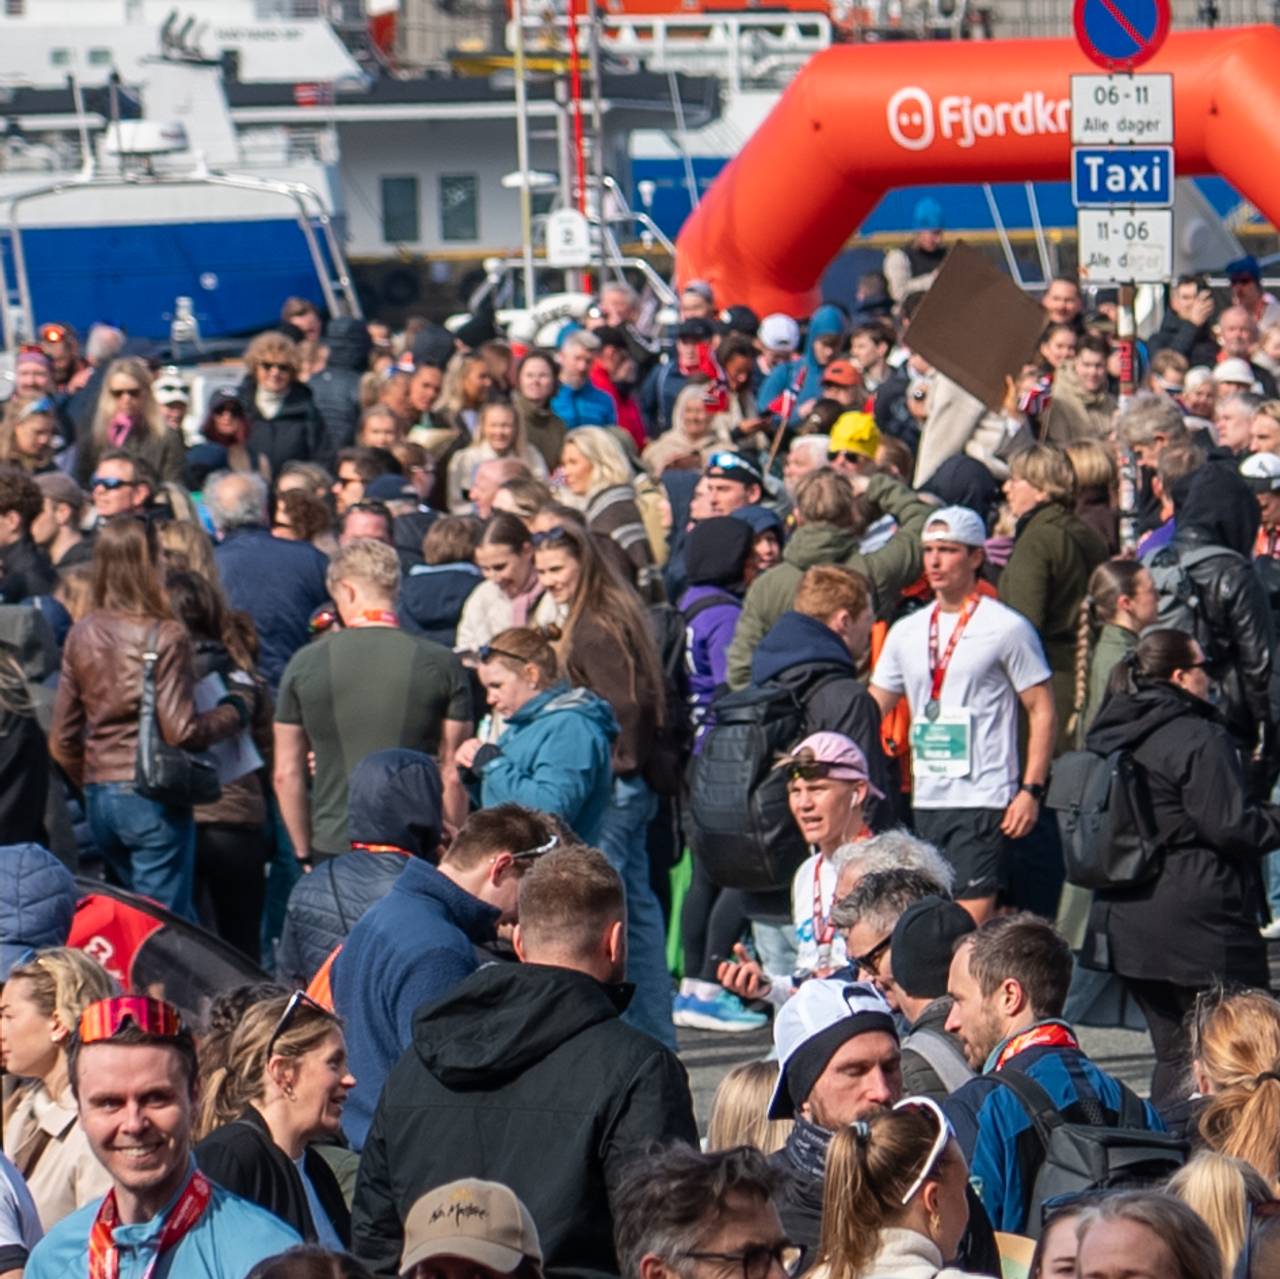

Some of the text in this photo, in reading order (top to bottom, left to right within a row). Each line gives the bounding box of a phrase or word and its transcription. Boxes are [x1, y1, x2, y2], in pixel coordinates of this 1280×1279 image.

[939, 91, 1071, 149] Fjordkr
[1083, 117, 1160, 135] Alle dager
[1083, 156, 1161, 193] Taxi
